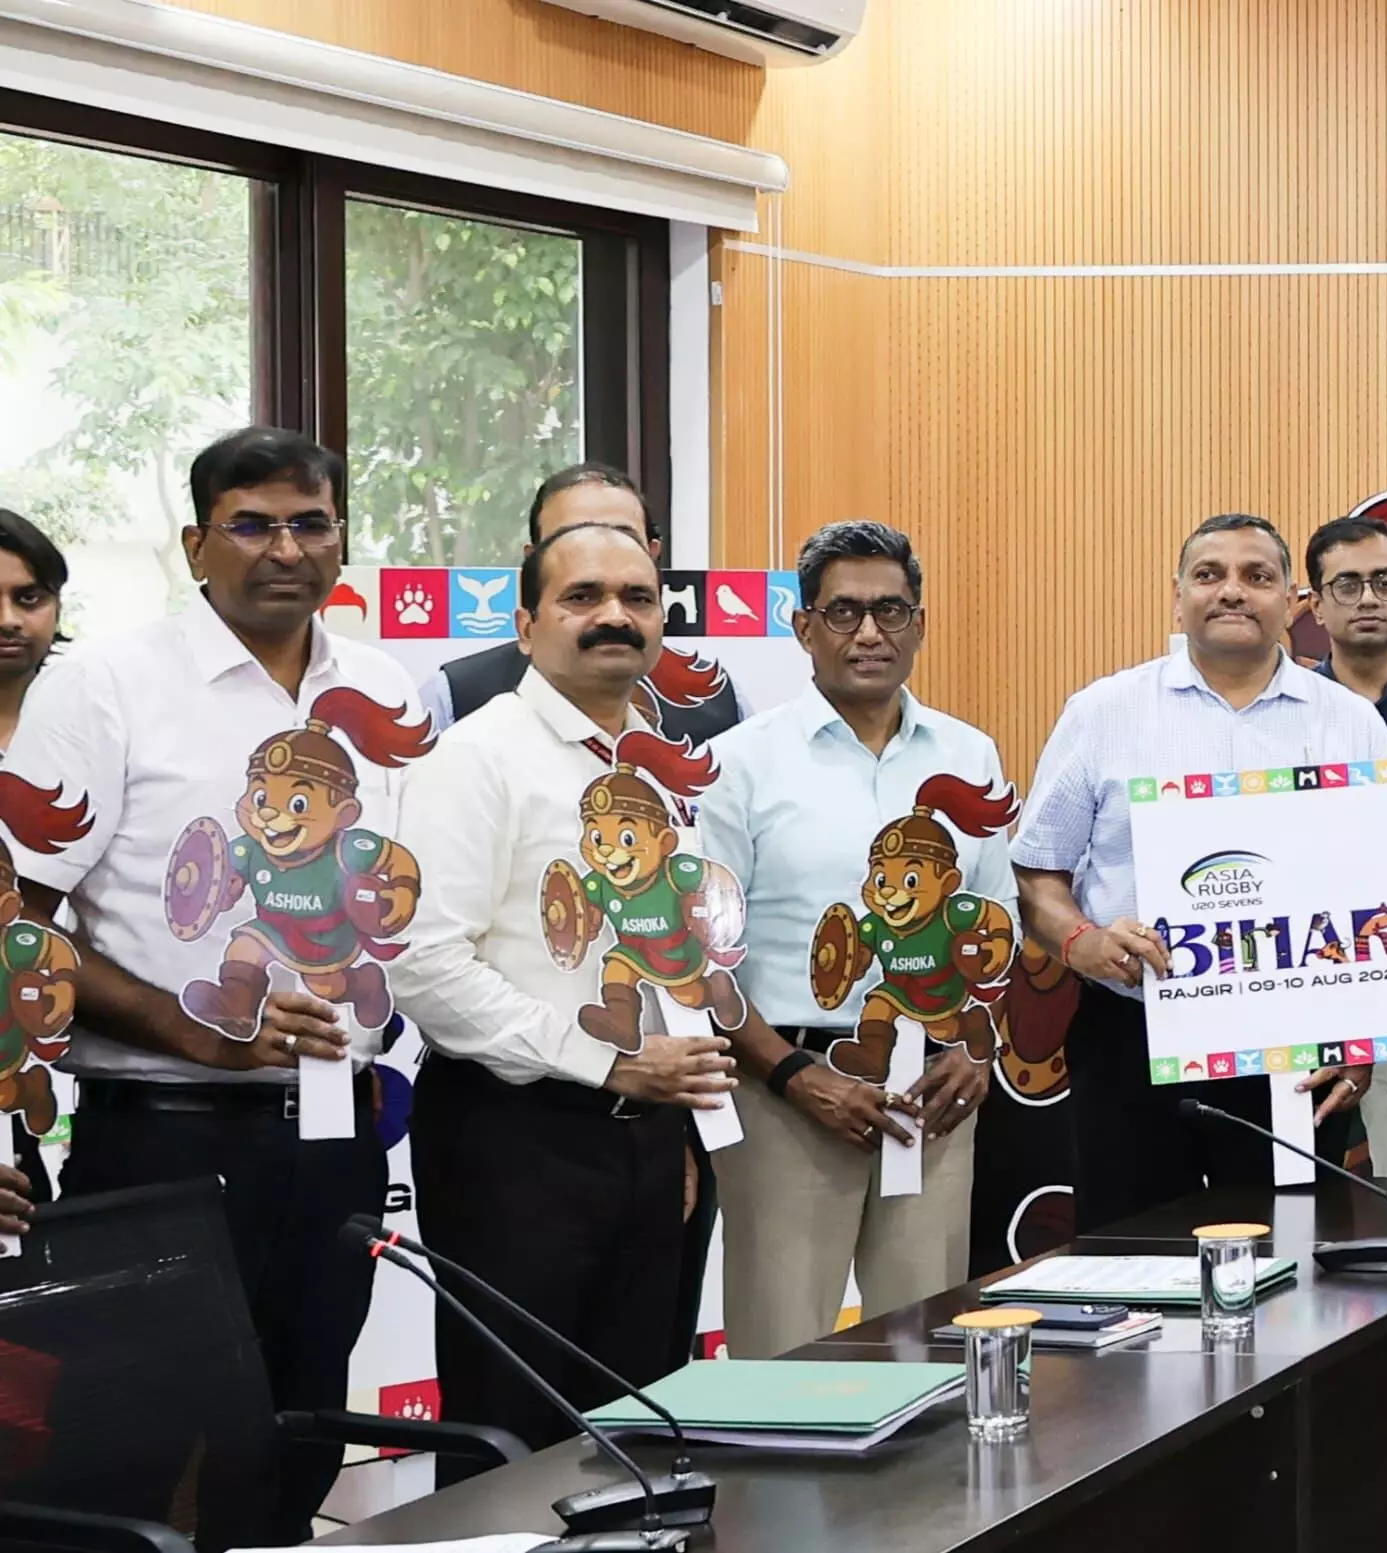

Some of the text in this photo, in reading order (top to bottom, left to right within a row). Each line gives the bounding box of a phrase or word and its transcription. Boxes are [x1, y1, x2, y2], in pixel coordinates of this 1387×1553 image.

[1204, 868, 1254, 882] ASIA
[1198, 880, 1264, 896] RUGBY
[264, 891, 323, 910] ASHOKA
[1192, 898, 1263, 911] U20 SEVENS
[621, 916, 669, 932] ASHOKA
[890, 955, 936, 971] ASHOKA
[1159, 983, 1233, 1001] RAJGIR
[1249, 977, 1304, 992] 09-10
[1311, 972, 1352, 987] AUG
